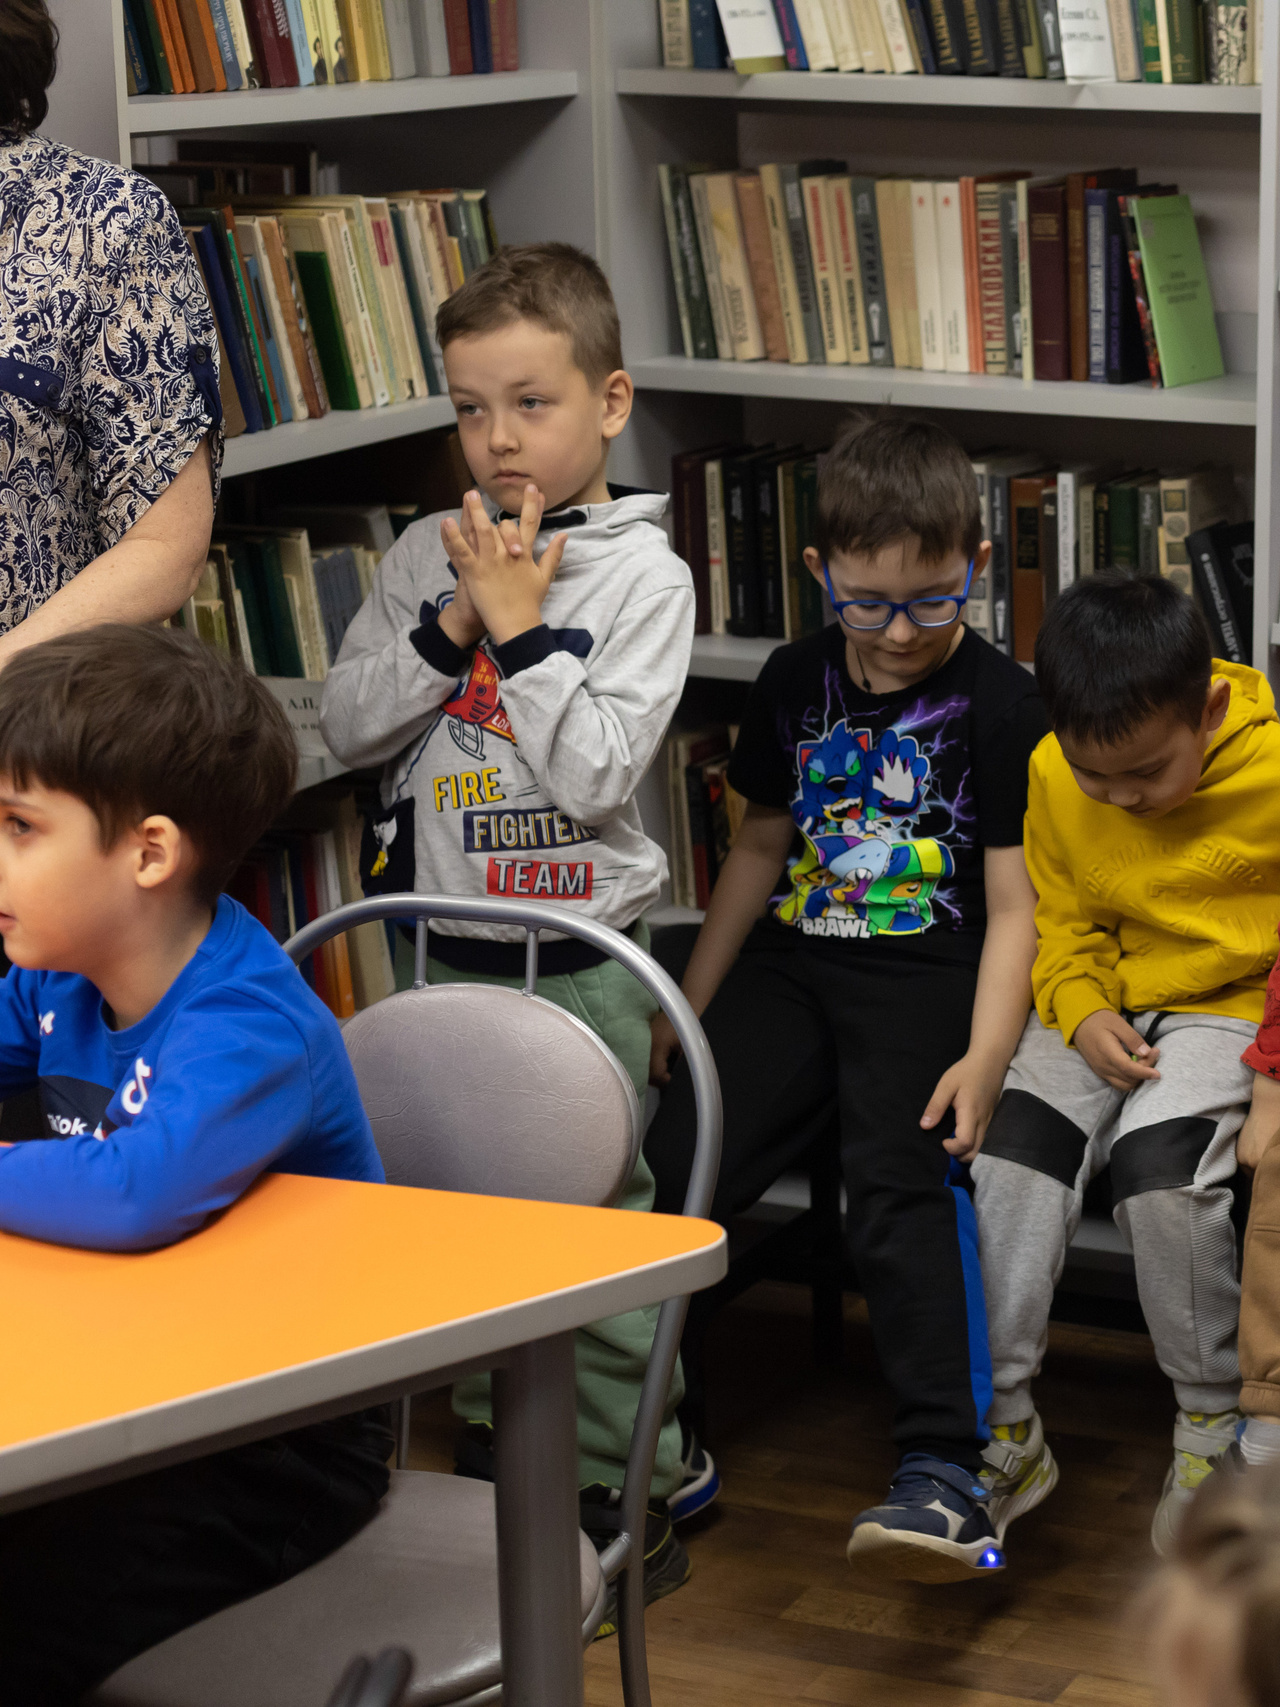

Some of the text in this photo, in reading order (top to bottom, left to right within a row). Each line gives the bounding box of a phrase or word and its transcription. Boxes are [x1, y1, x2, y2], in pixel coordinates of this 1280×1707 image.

[433, 767, 506, 812] FIRE
[494, 859, 587, 895] TEAM
[802, 916, 873, 938] BRAWL
